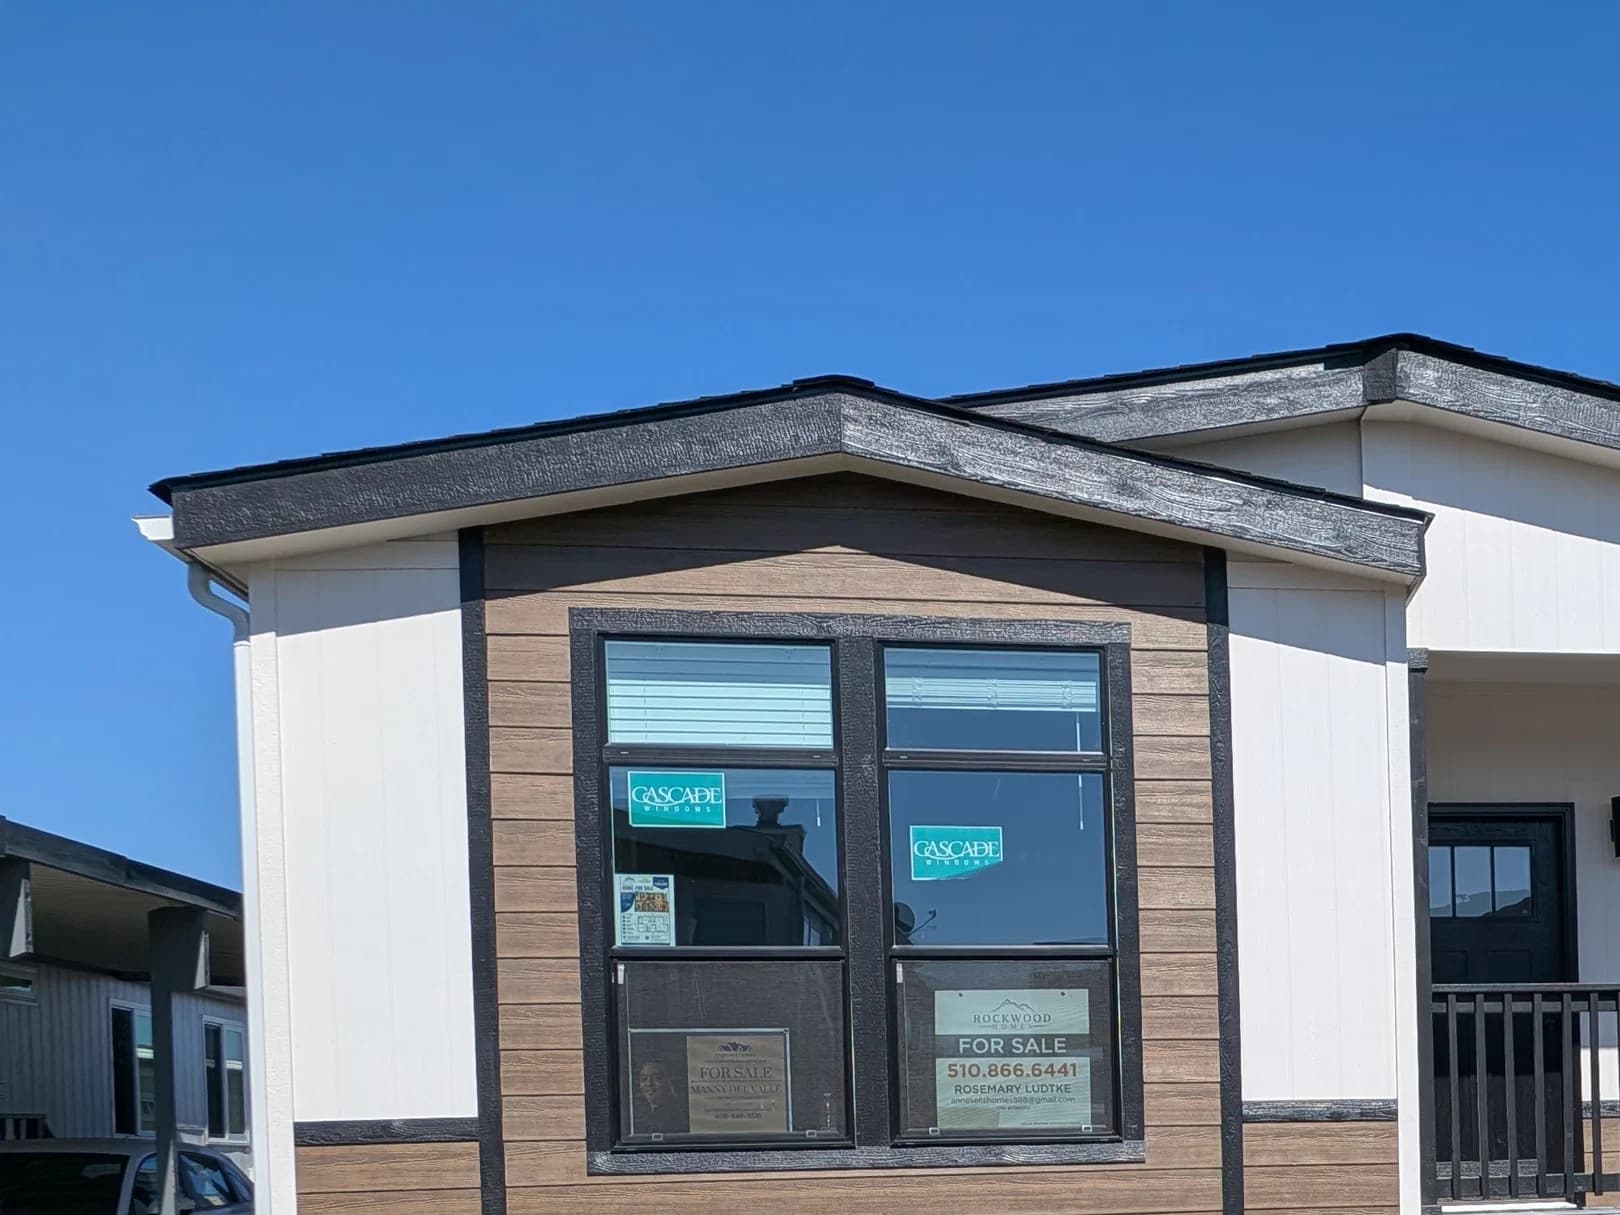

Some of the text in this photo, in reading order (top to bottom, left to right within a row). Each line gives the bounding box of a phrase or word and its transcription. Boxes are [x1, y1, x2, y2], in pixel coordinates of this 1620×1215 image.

[632, 786, 722, 806] CASCADE
[914, 840, 1000, 860] CASCADE
[974, 1014, 1051, 1023] ROCKWOOD
[959, 1038, 1066, 1053] FOR SALE
[700, 1067, 772, 1079] FOR SALE
[948, 1063, 1077, 1078] 510.866.6441
[954, 1083, 1072, 1095] ROSEMARY LUDTKE
